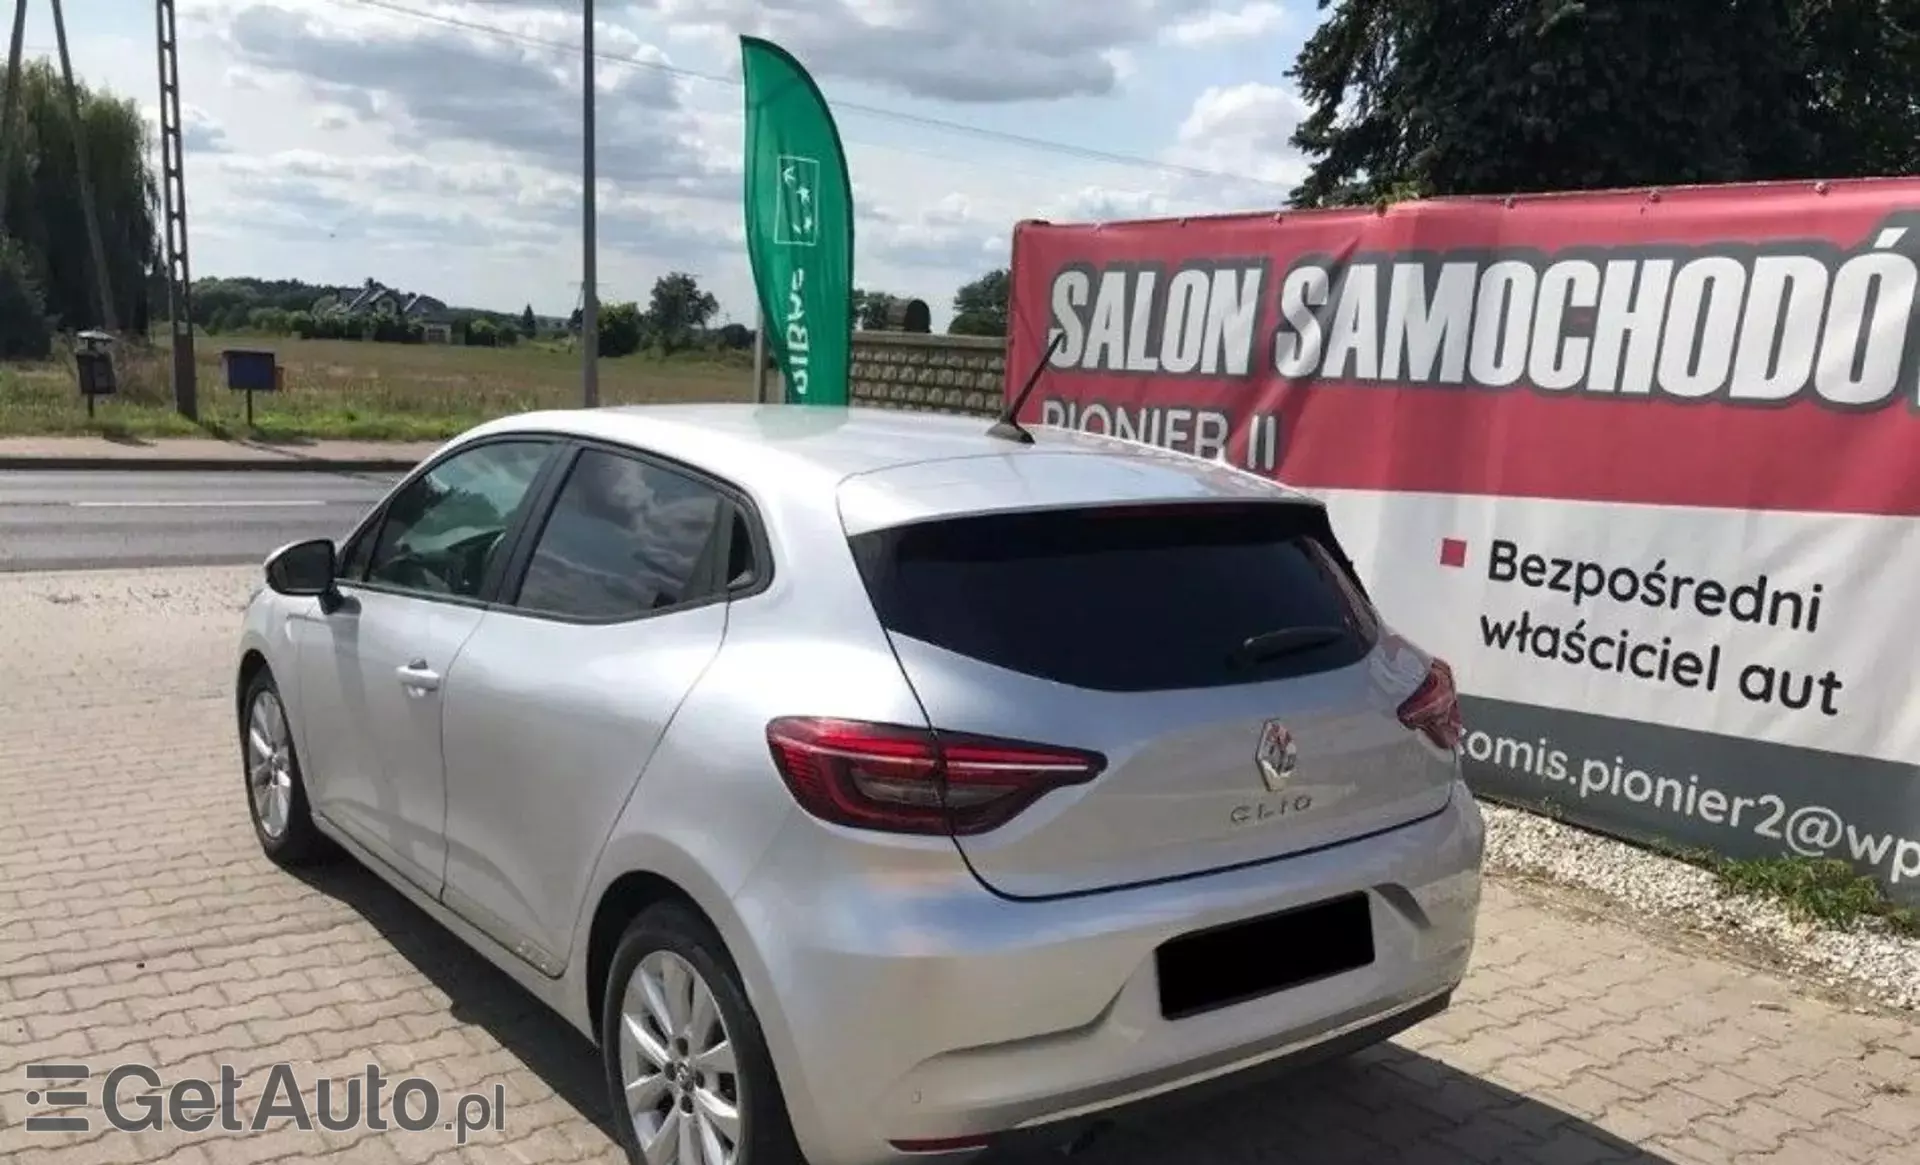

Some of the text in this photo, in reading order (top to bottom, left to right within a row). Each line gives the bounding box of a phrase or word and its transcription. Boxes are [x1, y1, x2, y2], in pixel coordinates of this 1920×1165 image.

[1048, 227, 1920, 405] SALON SAMOCHODÓ
[1488, 539, 1823, 633] Bezpośredni
[1480, 610, 1843, 716] właściciel aut
[1230, 794, 1313, 823] CLIO
[1460, 727, 1920, 884] omis.pionier2@wp
